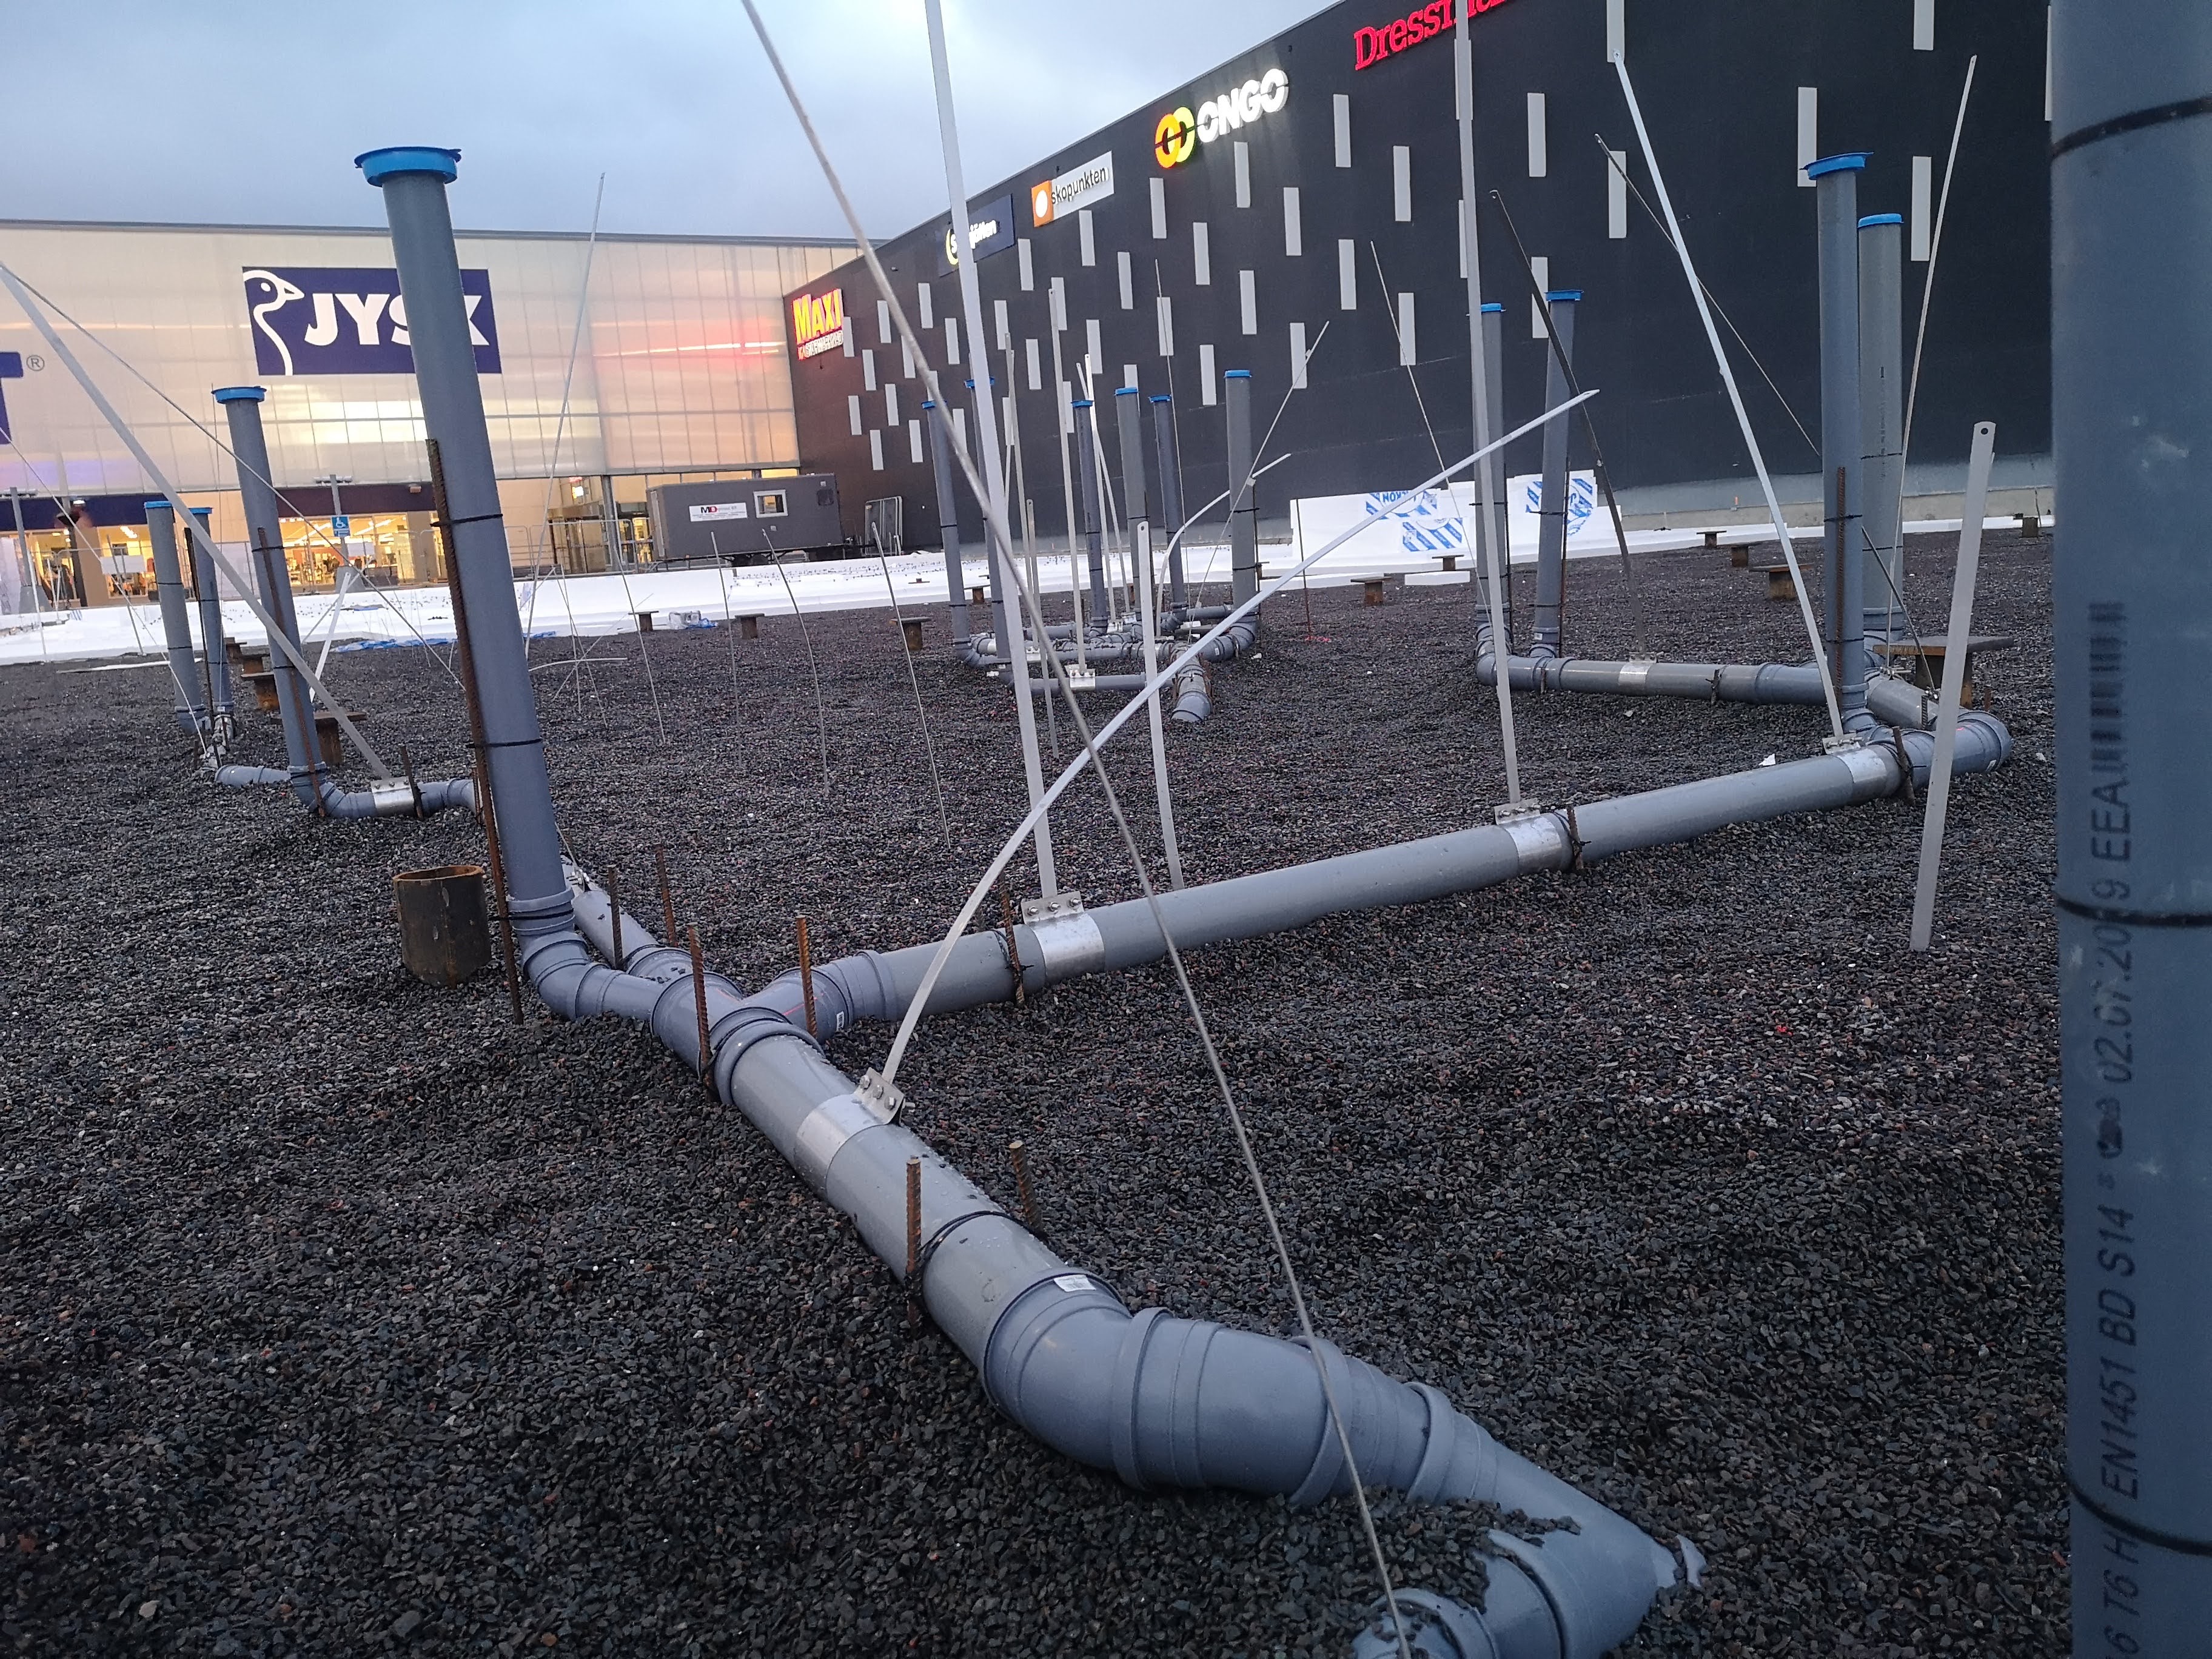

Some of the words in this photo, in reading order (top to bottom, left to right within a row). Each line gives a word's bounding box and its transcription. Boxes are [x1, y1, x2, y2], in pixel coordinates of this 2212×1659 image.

[1197, 68, 1289, 143] ONGO
[1051, 167, 1107, 204] skopunkten
[792, 288, 843, 345] MAXI
[2091, 877, 2132, 1083] 02.07.209
[2096, 1202, 2136, 1276] S14
[2097, 1288, 2137, 1346] BD
[2099, 1355, 2139, 1501] EN1451
[2103, 1625, 2140, 1659] 6
